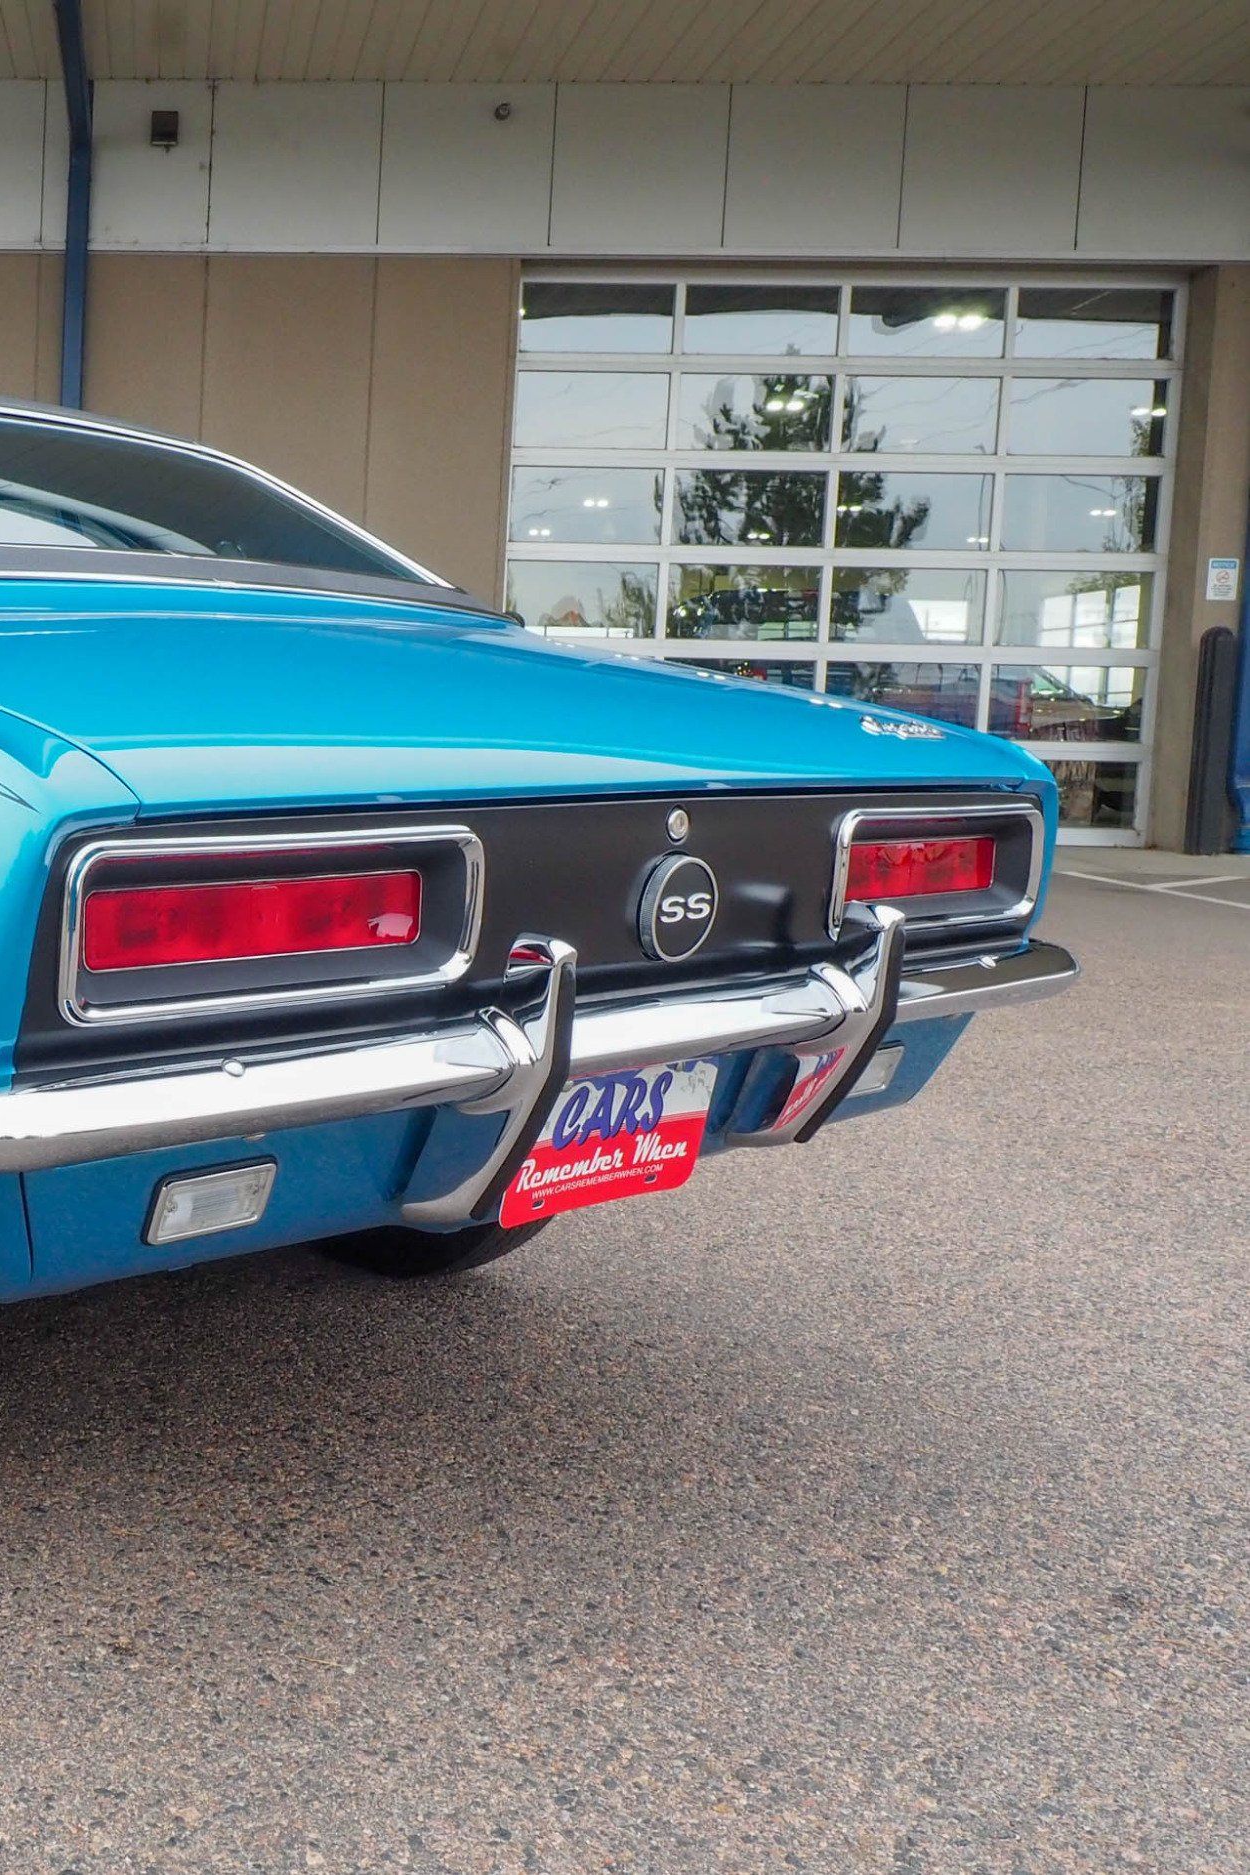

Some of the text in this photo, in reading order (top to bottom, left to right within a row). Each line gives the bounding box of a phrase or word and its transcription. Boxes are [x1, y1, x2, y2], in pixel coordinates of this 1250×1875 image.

[659, 892, 712, 923] SS
[552, 1071, 674, 1151] CARS
[516, 1132, 688, 1194] Remember When
[531, 1163, 664, 1200] WWW.CARSREMEMBERWHEN.COM
